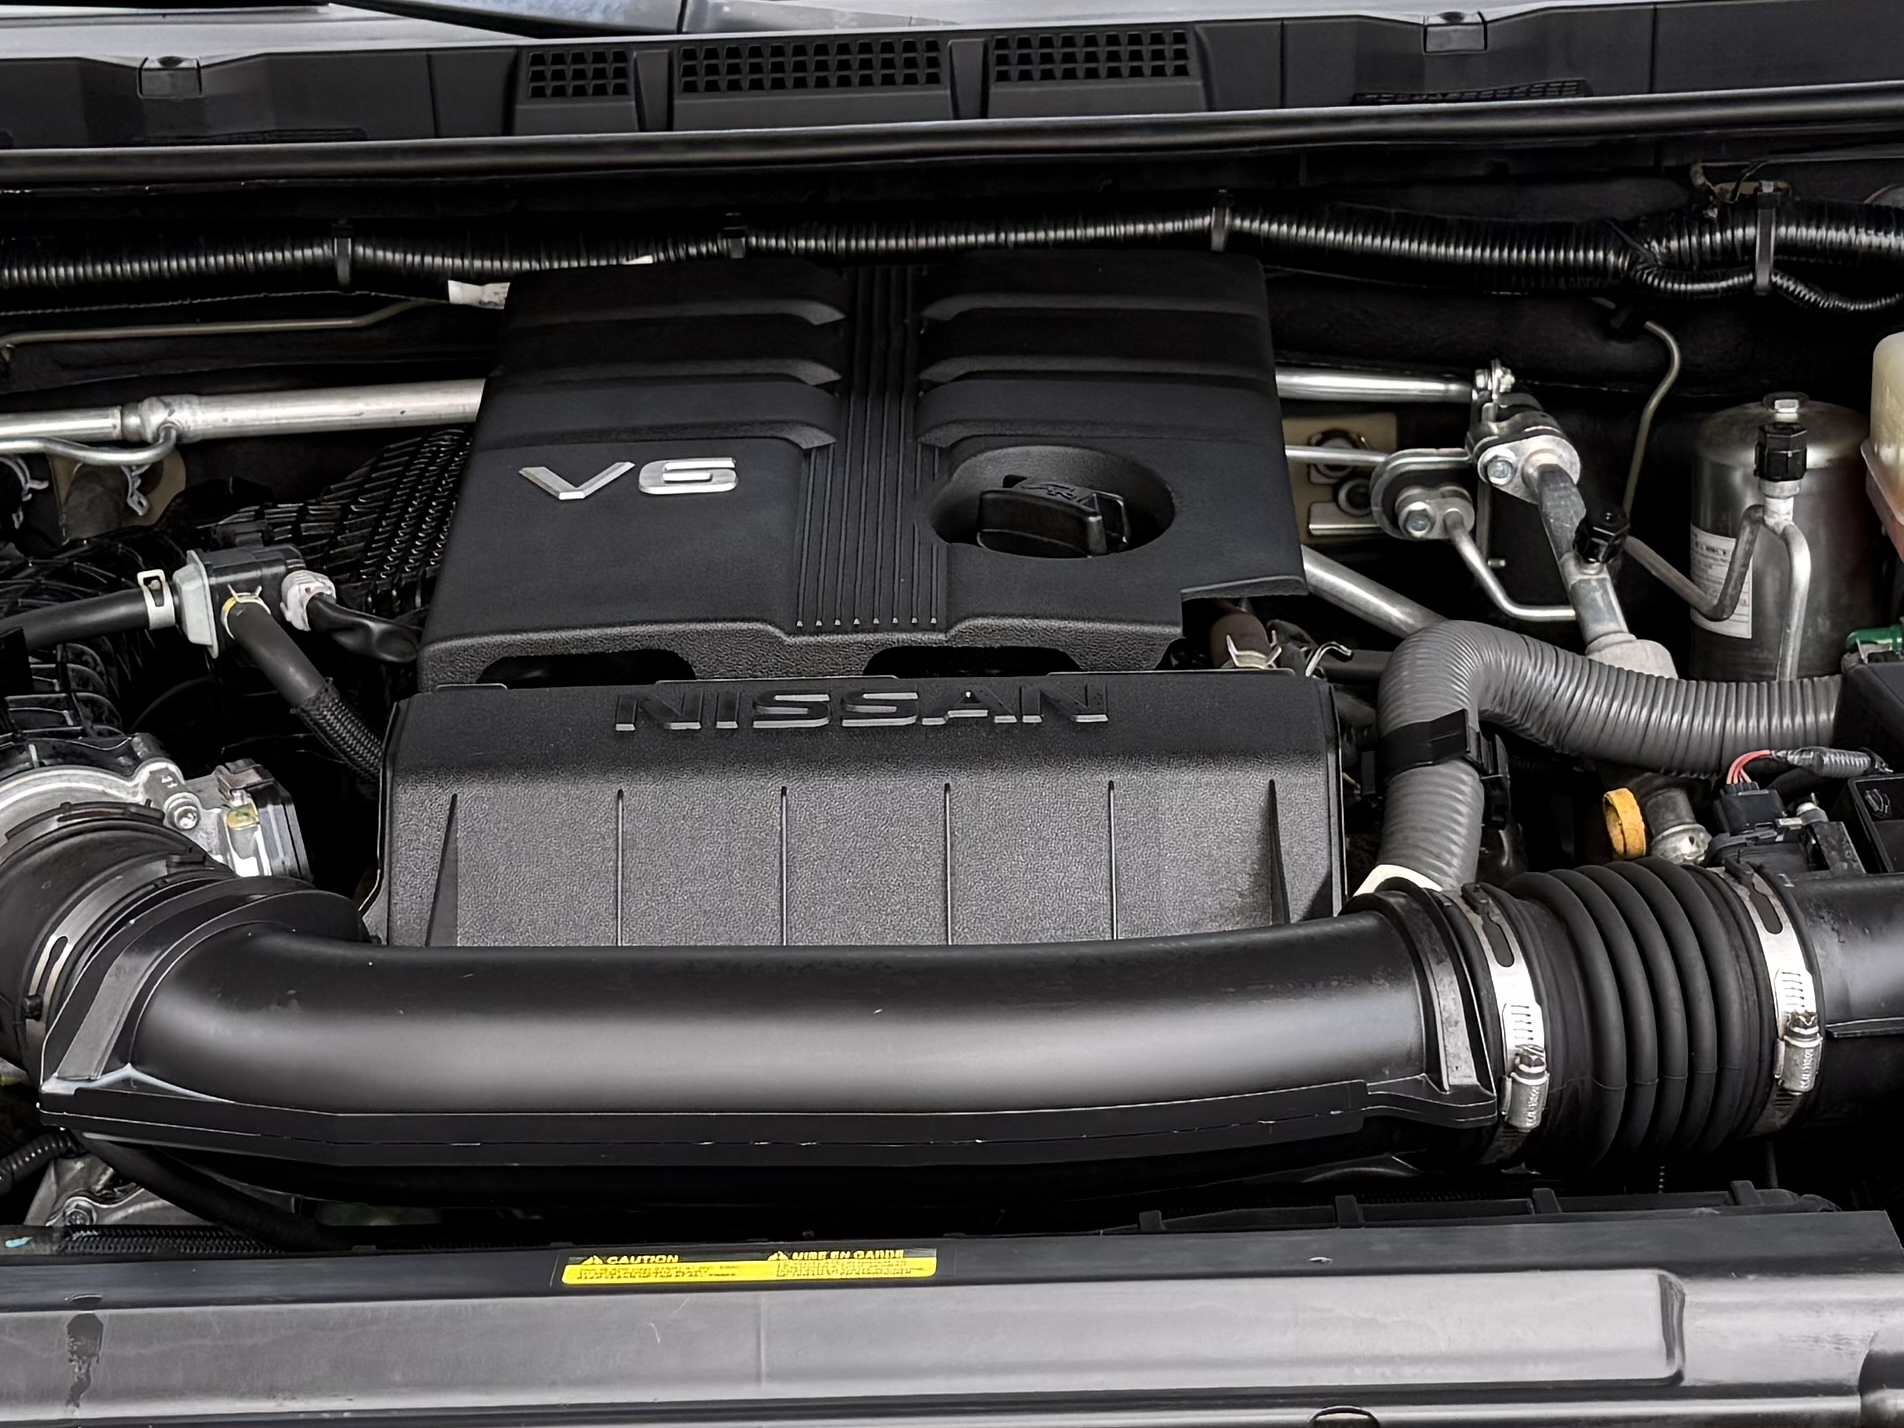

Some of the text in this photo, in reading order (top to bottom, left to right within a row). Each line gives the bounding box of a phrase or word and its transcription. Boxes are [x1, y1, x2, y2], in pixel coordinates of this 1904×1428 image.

[518, 457, 738, 500] V6
[615, 683, 1109, 731] NISSAN
[606, 1255, 679, 1265] CAUTION
